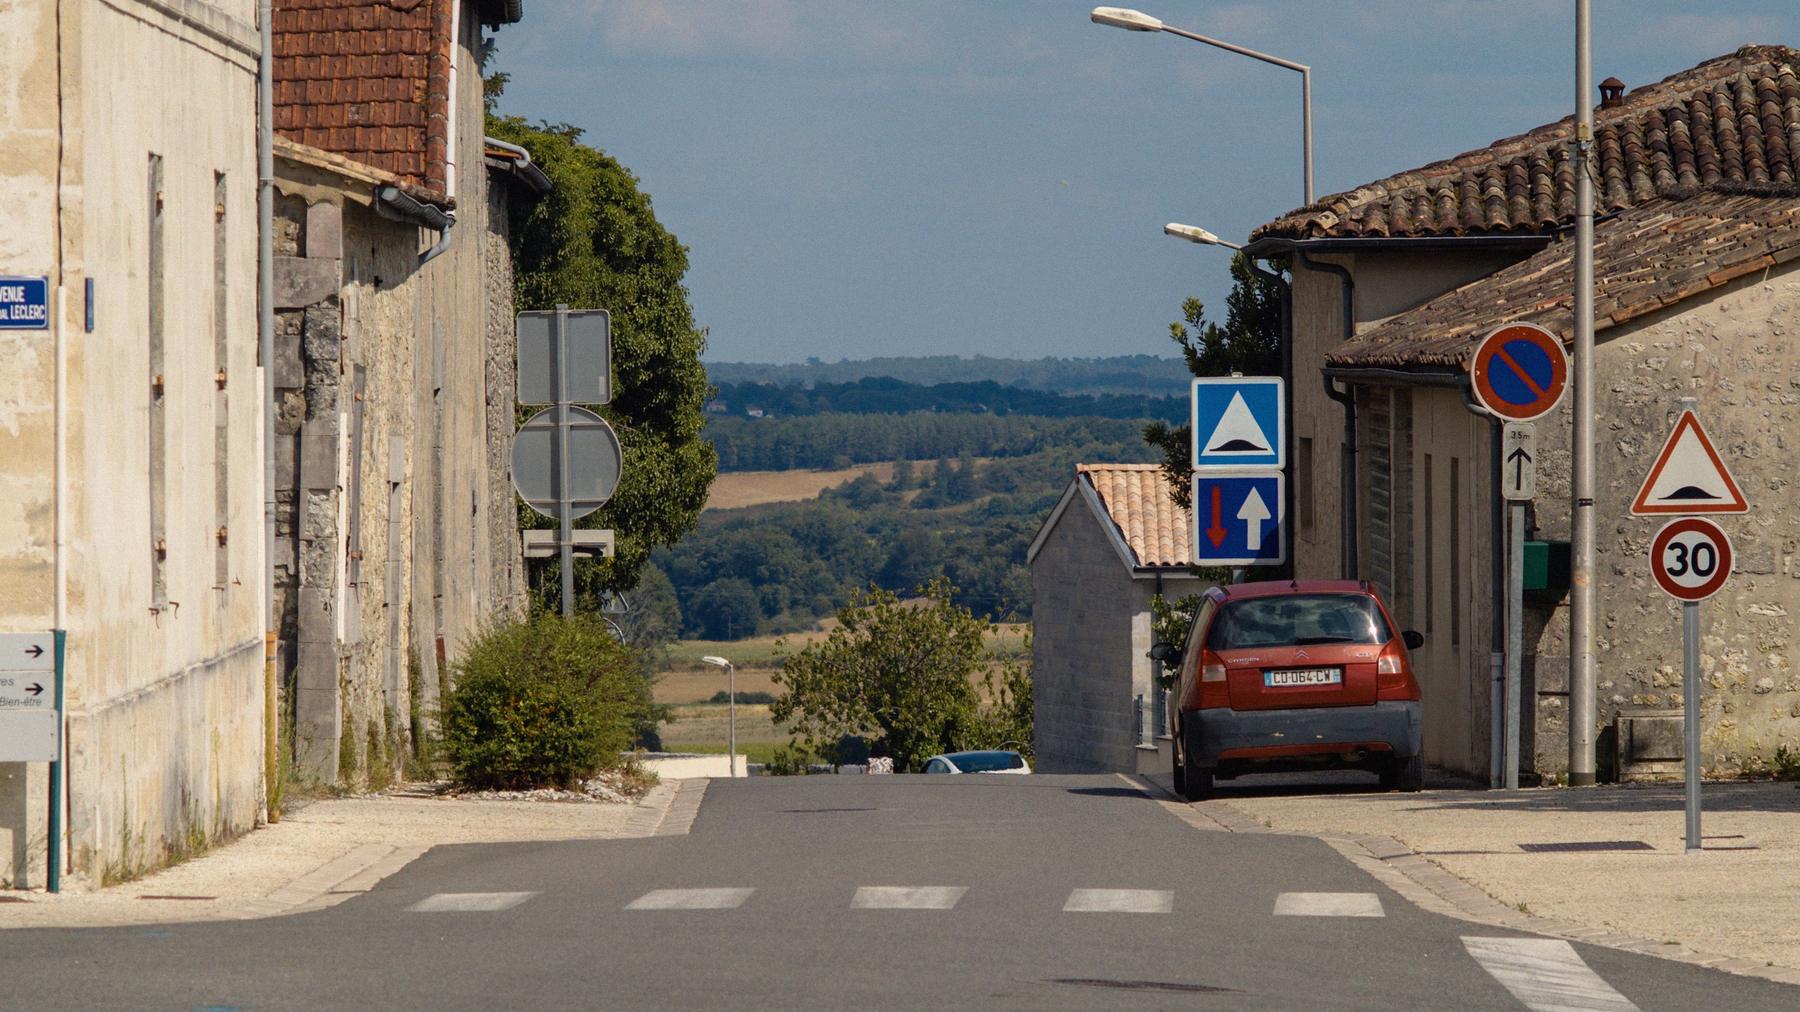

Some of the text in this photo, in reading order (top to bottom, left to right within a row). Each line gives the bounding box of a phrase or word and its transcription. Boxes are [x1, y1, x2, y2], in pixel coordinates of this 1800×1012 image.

[10, 304, 45, 320] LECLERC
[1511, 430, 1530, 440] 35m
[1667, 541, 1716, 577] 30
